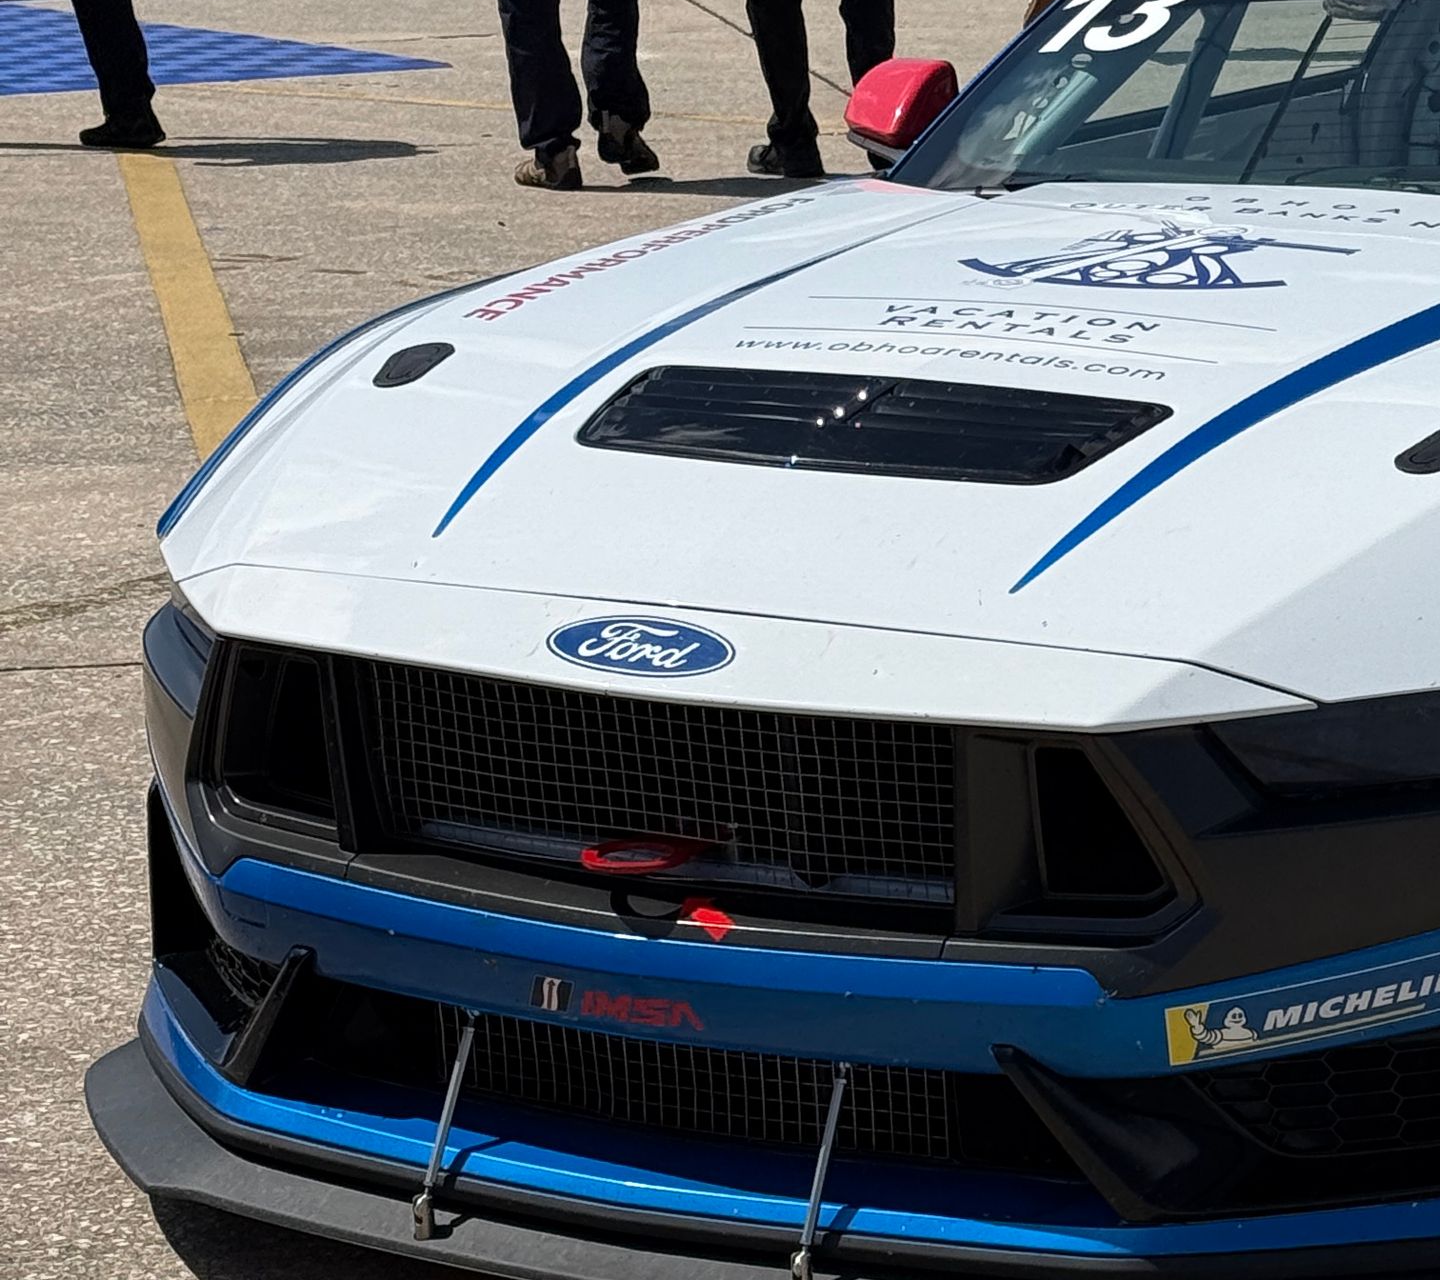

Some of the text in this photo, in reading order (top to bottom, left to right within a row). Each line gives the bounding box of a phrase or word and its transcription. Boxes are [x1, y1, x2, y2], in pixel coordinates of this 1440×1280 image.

[1069, 201, 1213, 213] OUTER
[1233, 206, 1388, 225] BANKS
[877, 315, 1137, 345] RENTALS
[883, 303, 1161, 333] VACATION
[733, 338, 1168, 382] www.obhoarentals.com
[577, 621, 701, 669] Ford
[580, 989, 705, 1032] IMSA
